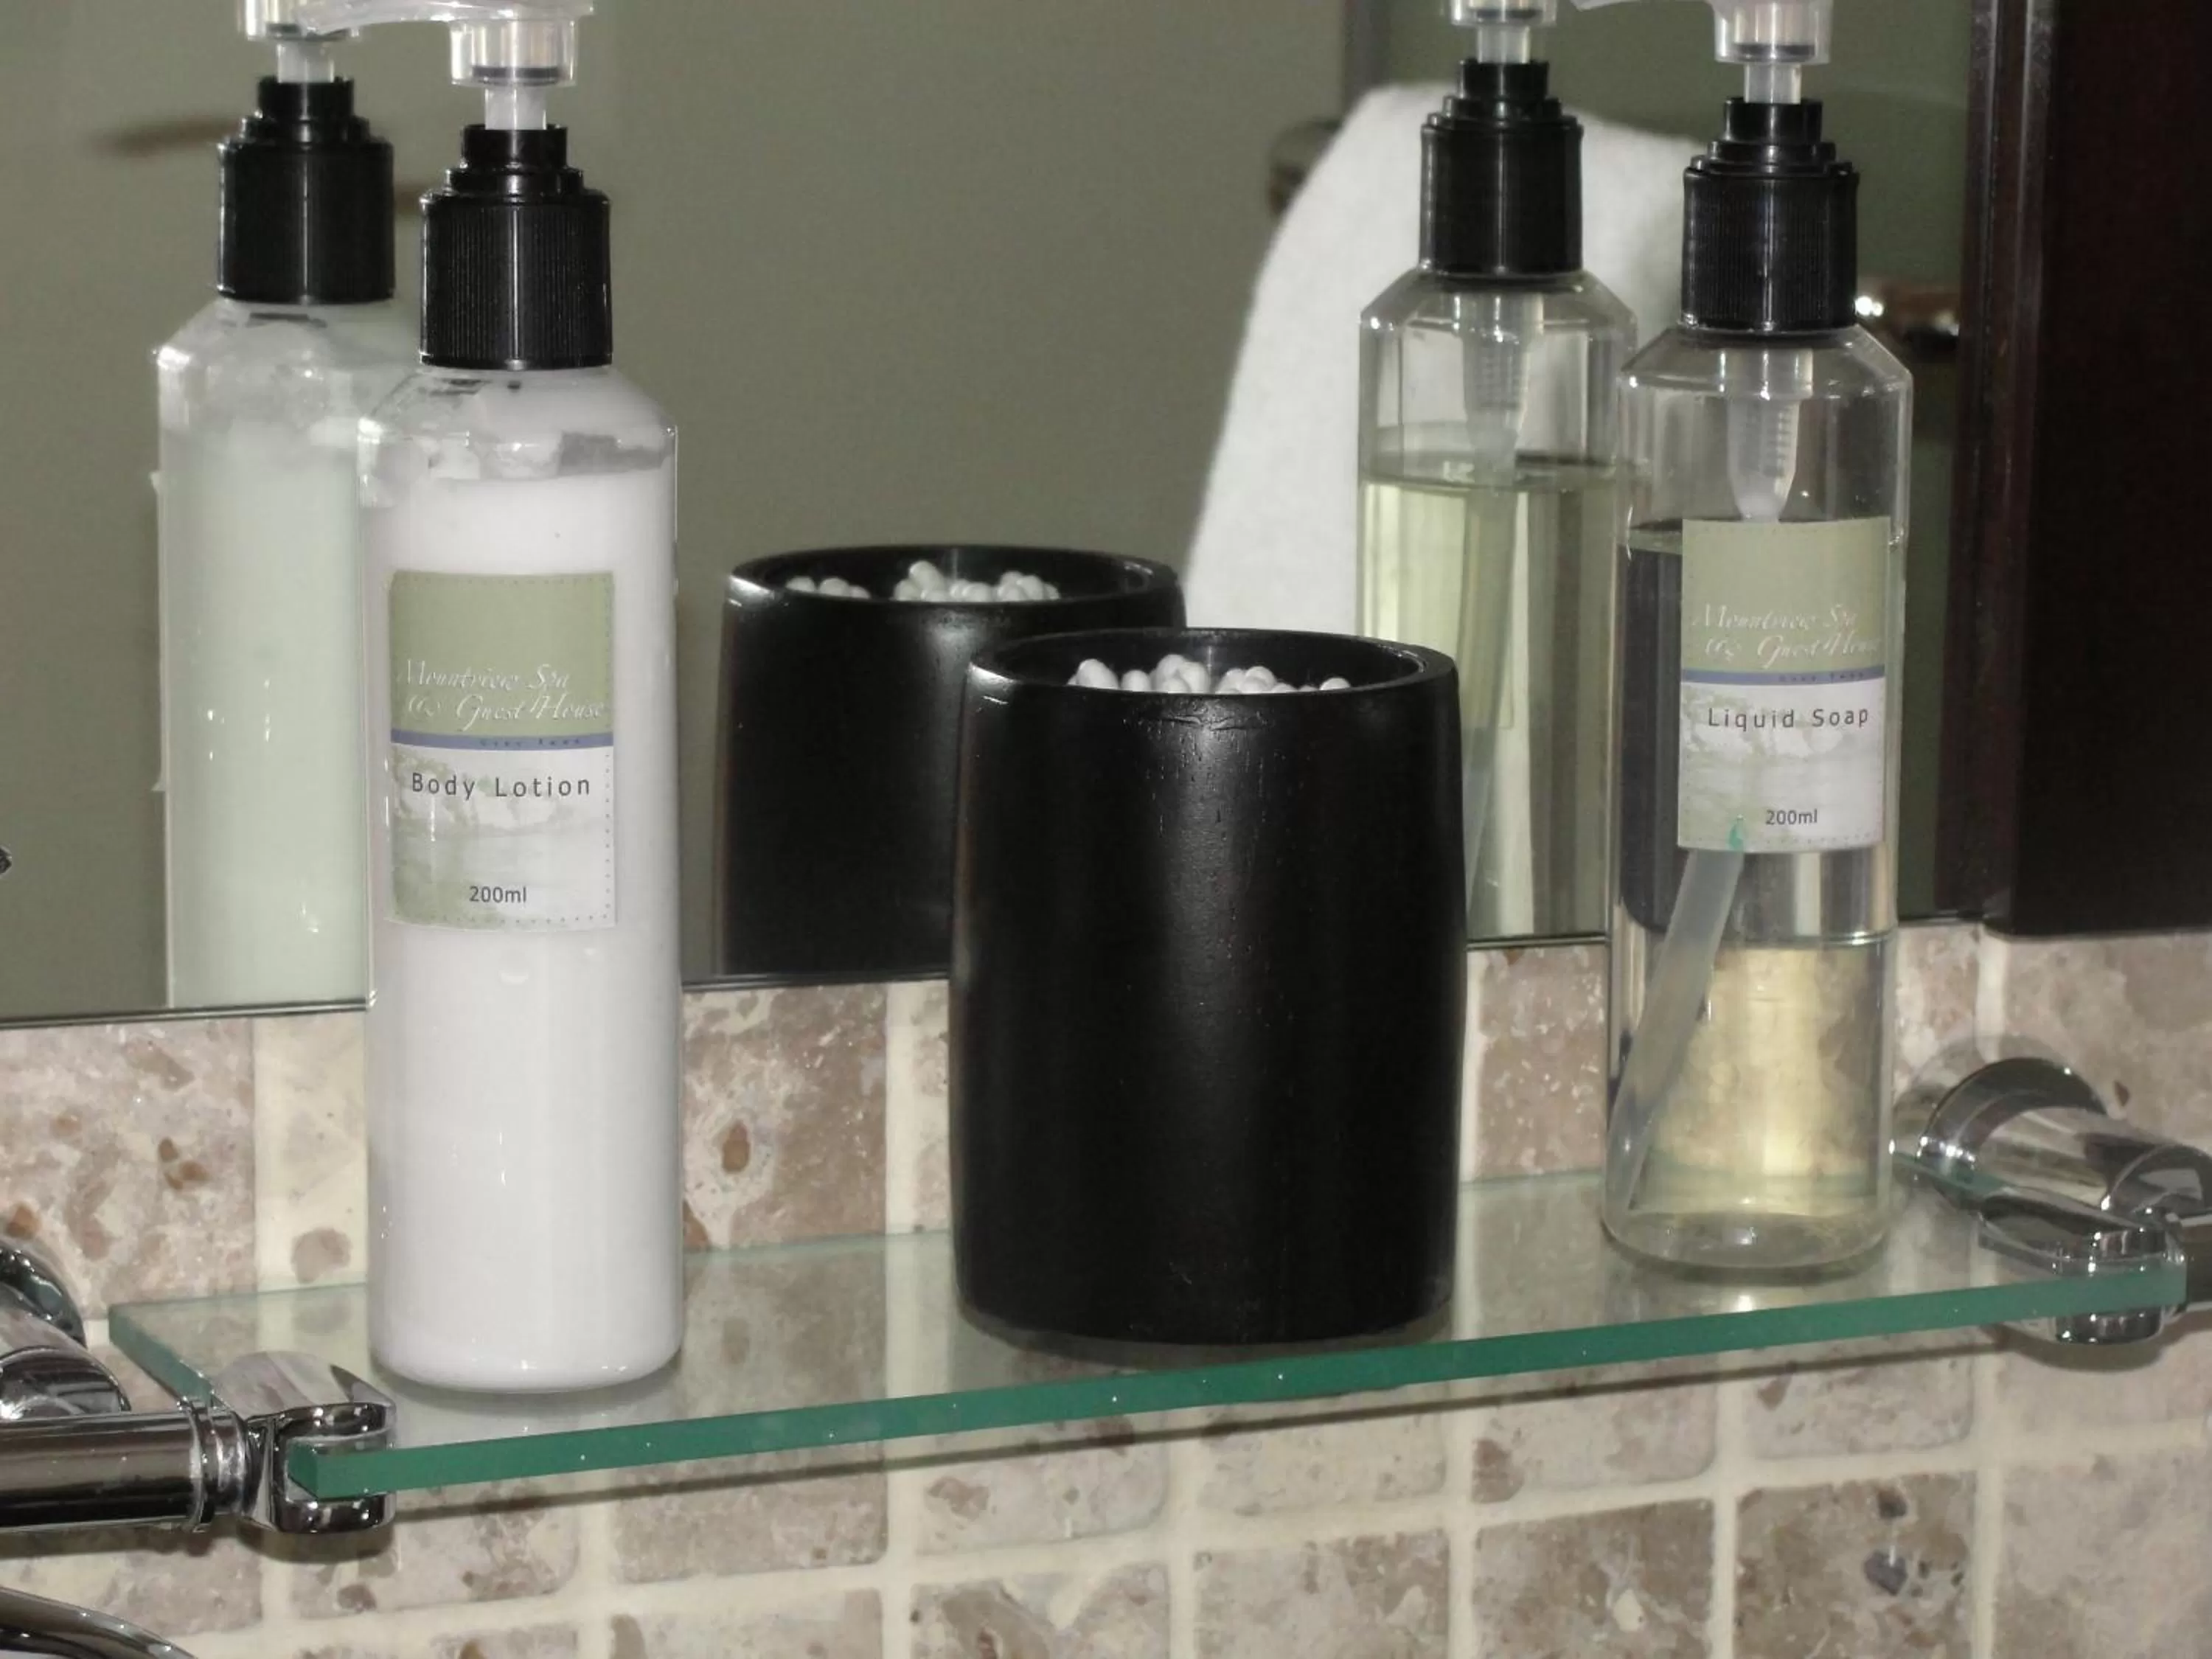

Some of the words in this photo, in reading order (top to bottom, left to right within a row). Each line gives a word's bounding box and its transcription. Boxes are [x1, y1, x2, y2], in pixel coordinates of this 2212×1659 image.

[1708, 707, 1795, 731] Liquid
[1812, 708, 1869, 728] Soap
[411, 772, 476, 800] Body
[495, 776, 590, 798] Lotion
[1765, 809, 1818, 826] 200ml
[469, 886, 527, 903] 200ml
